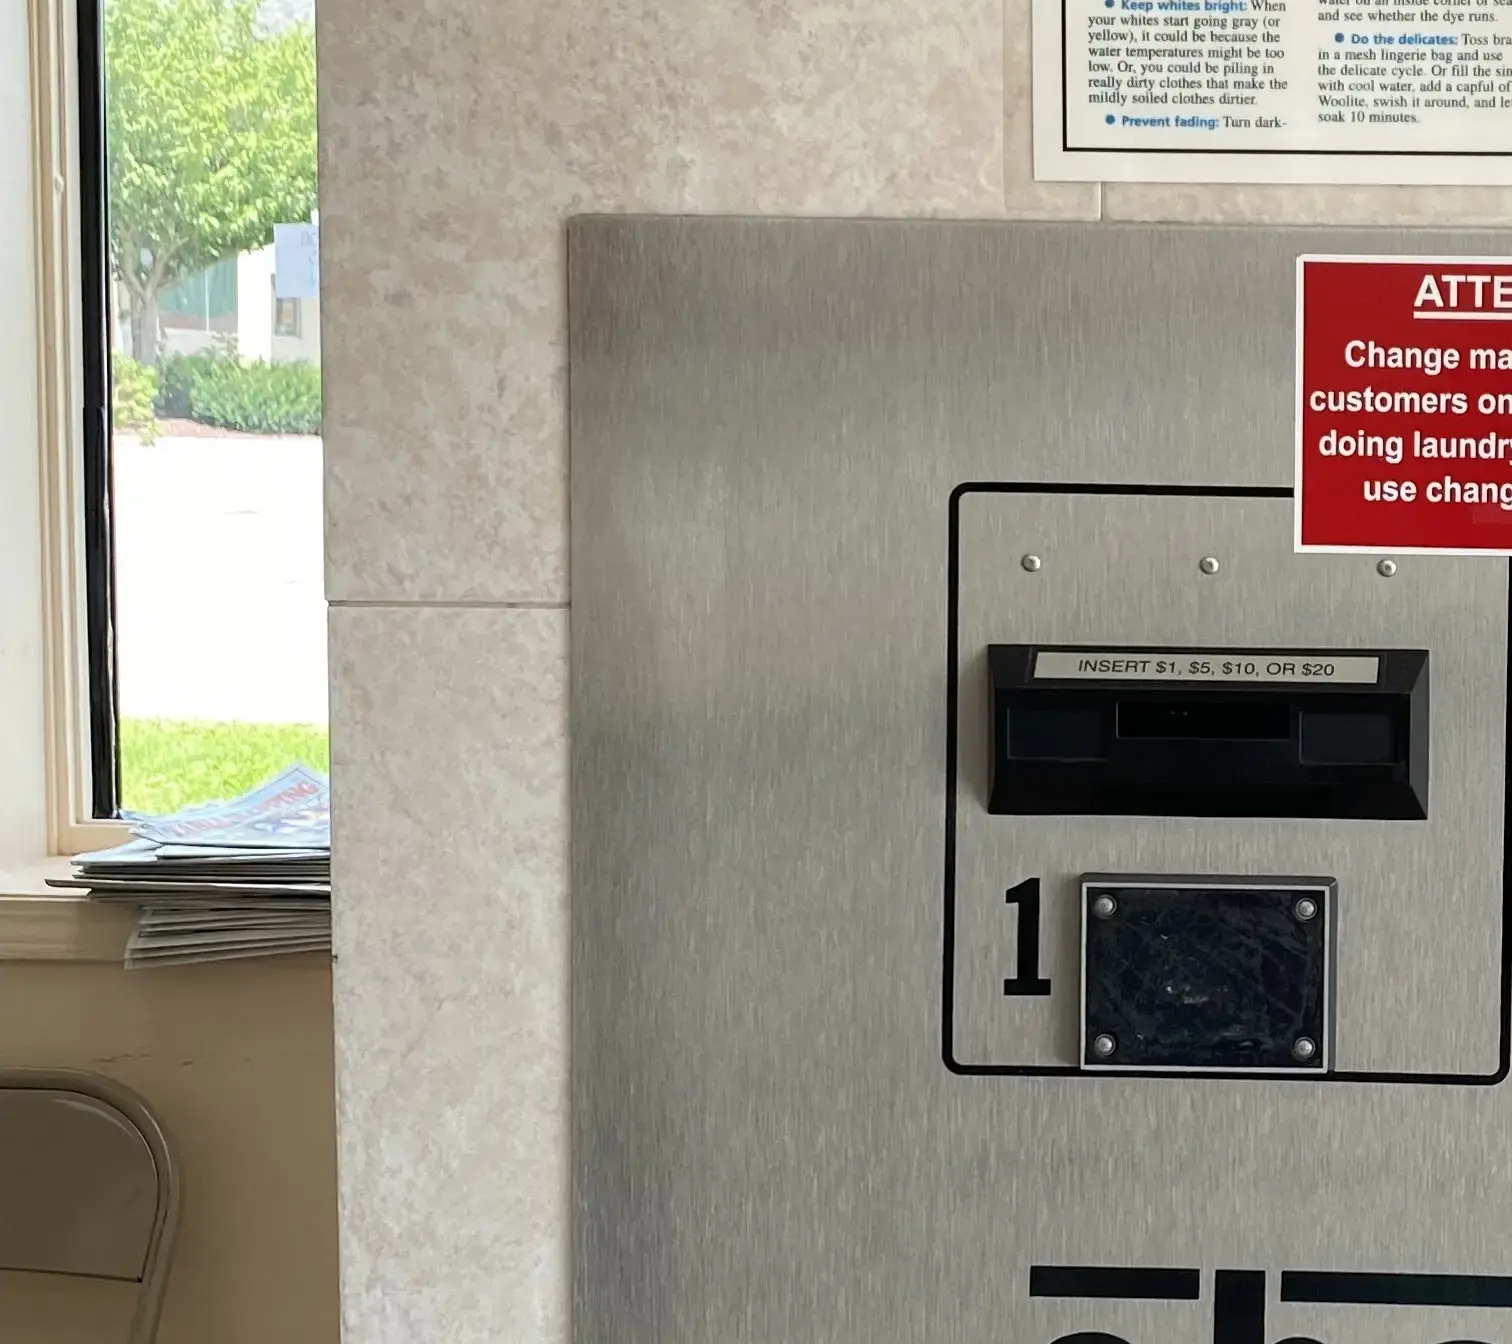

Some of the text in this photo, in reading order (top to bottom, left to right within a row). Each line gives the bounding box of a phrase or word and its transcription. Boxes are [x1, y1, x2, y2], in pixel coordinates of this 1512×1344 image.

[1121, 0, 1153, 13] Keep
[1204, 0, 1247, 14] bright:
[1250, 0, 1286, 12] When
[1351, 33, 1369, 44] Do
[1373, 33, 1395, 45] the
[1398, 33, 1458, 45] delicates:
[1461, 33, 1488, 45] Toss
[1122, 115, 1286, 131] Prevent fading: Turn dark-
[1318, 110, 1418, 123] soak 10 minutes.
[1345, 340, 1460, 375] Change
[1310, 386, 1468, 414] customers
[1319, 429, 1403, 464] doing
[1364, 481, 1417, 502] use
[1079, 660, 1334, 676] INSERT $1, $5, $10, OR $20
[1004, 878, 1051, 995] 1
